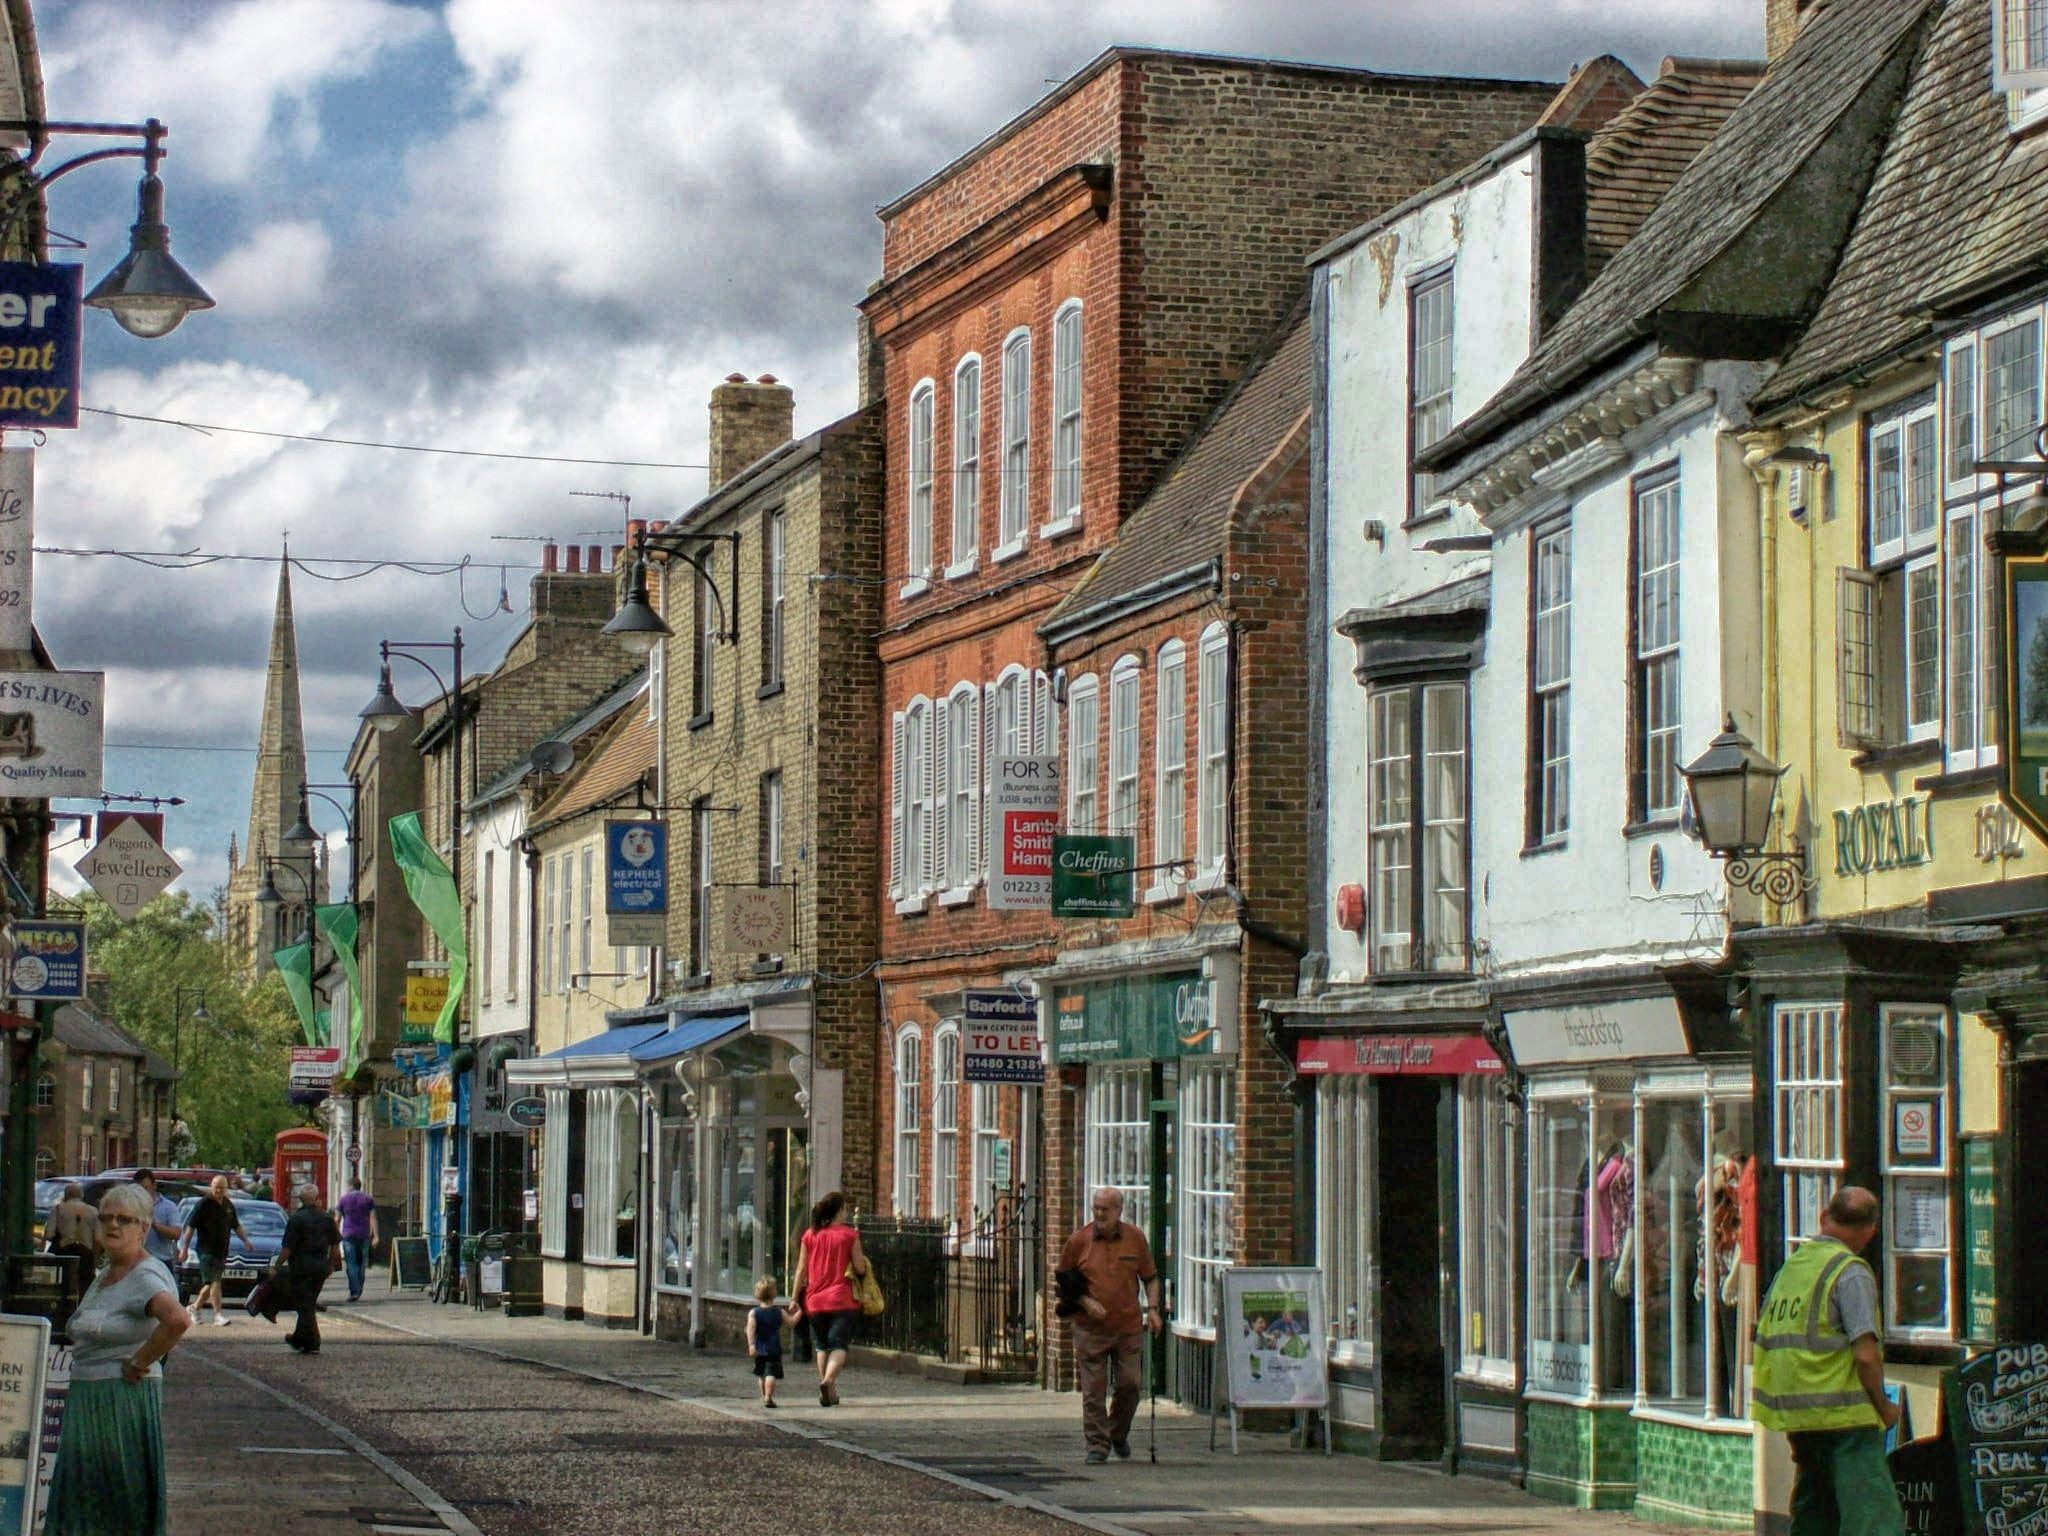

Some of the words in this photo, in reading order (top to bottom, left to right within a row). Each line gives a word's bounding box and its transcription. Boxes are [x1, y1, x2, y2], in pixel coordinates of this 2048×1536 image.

[0, 292, 57, 328] er
[0, 341, 57, 371] ent
[0, 386, 68, 416] ncy
[2, 765, 48, 781] Quality
[51, 766, 87, 778] Meats
[1003, 761, 1040, 779] FOR
[1046, 761, 1059, 779] S
[109, 838, 153, 850] Piggotts
[1833, 796, 1922, 879] ROYAL
[89, 858, 172, 879] Jewellers
[1059, 850, 1126, 873] Cheffins
[613, 869, 661, 879] HEPHERS
[613, 879, 662, 889] electrical
[1003, 881, 1040, 893] 01223
[1063, 897, 1121, 908] cheffins.co.uk
[1175, 982, 1211, 1033] Cheffin
[967, 1023, 989, 1032] TOWN
[972, 1034, 1000, 1051] TO
[1007, 1036, 1042, 1052] LET
[1355, 1038, 1371, 1065] The
[966, 1057, 1005, 1070] 01480
[347, 1149, 360, 1159] 20
[1995, 1343, 2048, 1374] PUB
[1, 1362, 24, 1376] RN
[1993, 1364, 2048, 1397] FOOD
[1970, 1446, 2037, 1477] REAL
